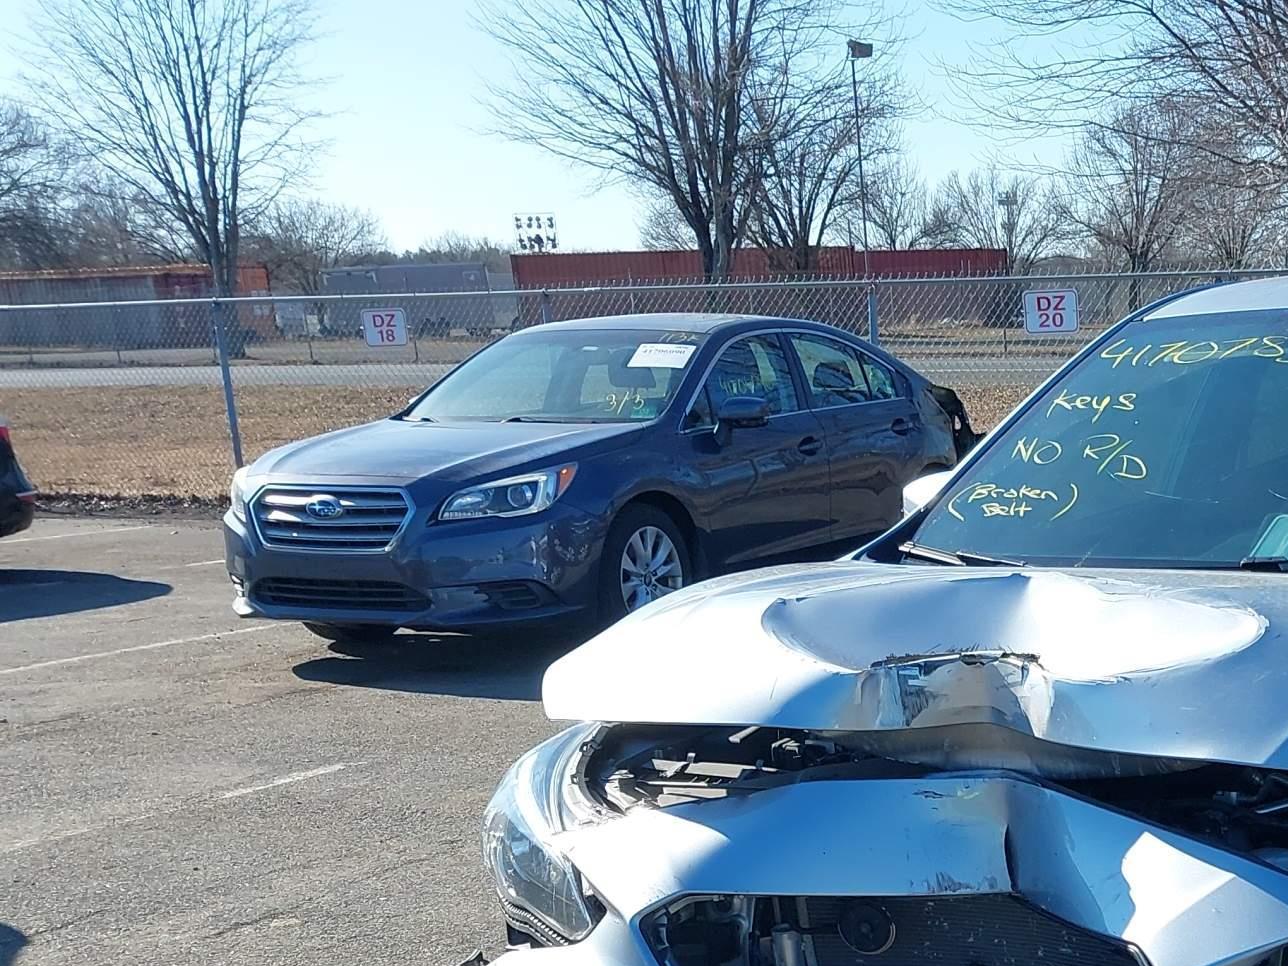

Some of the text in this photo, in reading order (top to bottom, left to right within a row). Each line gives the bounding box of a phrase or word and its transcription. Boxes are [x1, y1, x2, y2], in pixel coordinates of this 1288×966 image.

[1036, 295, 1066, 311] DZ
[372, 314, 397, 328] DZ
[1039, 312, 1064, 328] 20
[377, 329, 395, 342] 18
